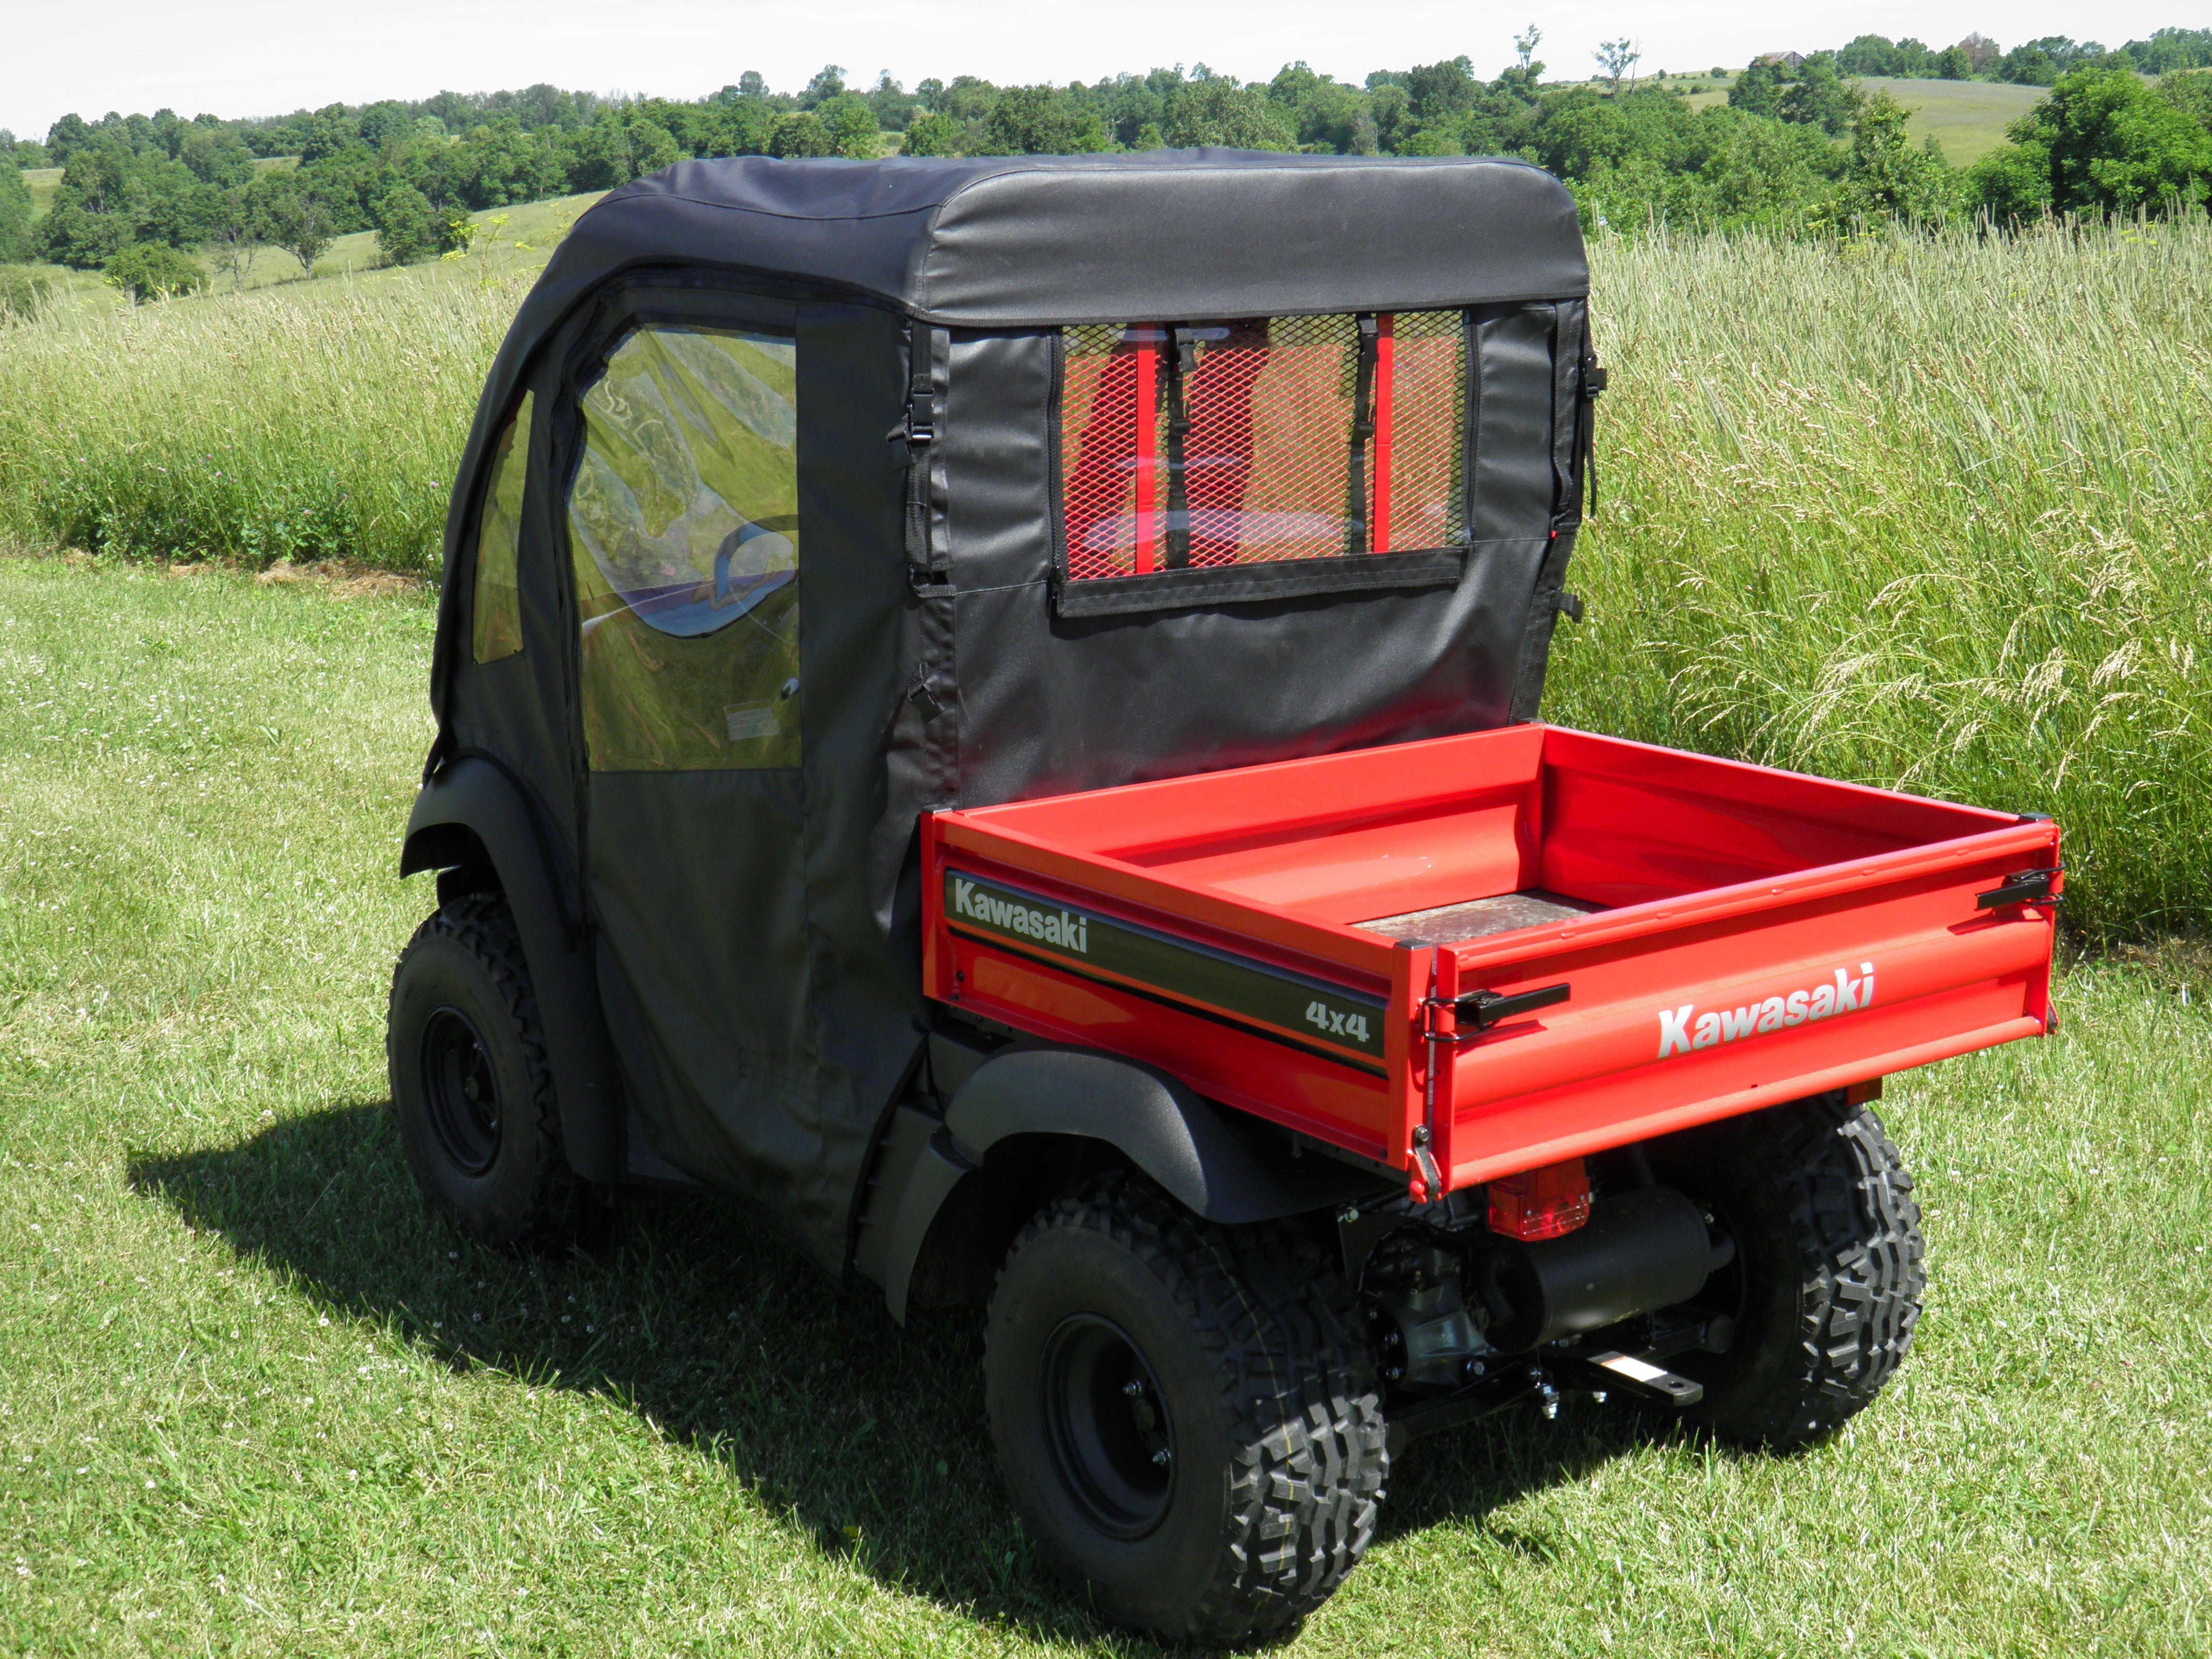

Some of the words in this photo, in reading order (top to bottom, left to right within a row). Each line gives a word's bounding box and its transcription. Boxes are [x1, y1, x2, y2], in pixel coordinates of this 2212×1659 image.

[956, 879, 1087, 953] Kawasaki
[1306, 1001, 1370, 1042] 4x4
[1658, 962, 1874, 1059] Kawasaki
